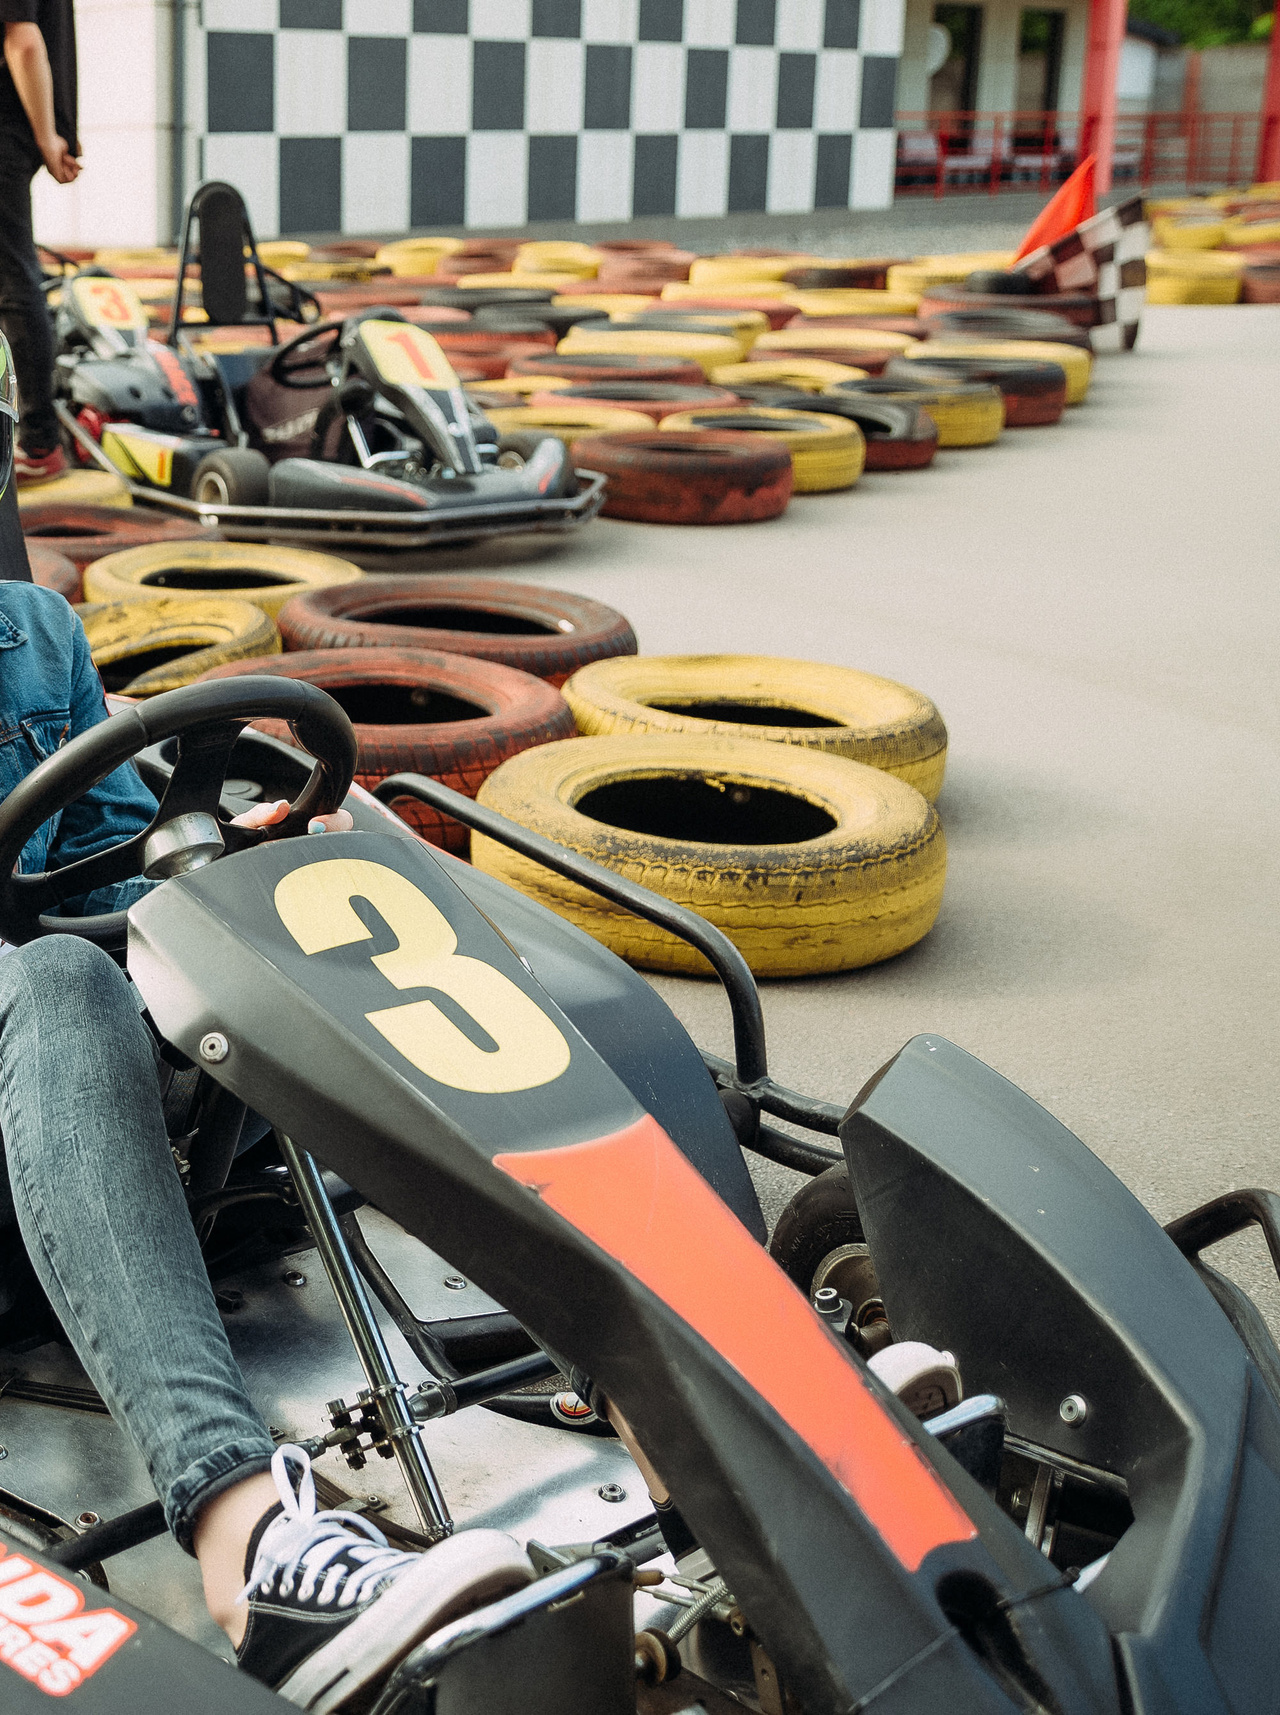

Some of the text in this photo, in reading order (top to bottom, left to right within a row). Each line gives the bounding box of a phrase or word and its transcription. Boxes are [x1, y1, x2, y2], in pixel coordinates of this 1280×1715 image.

[90, 285, 131, 321] 3
[385, 331, 437, 380] 1
[274, 858, 571, 1094] 3
